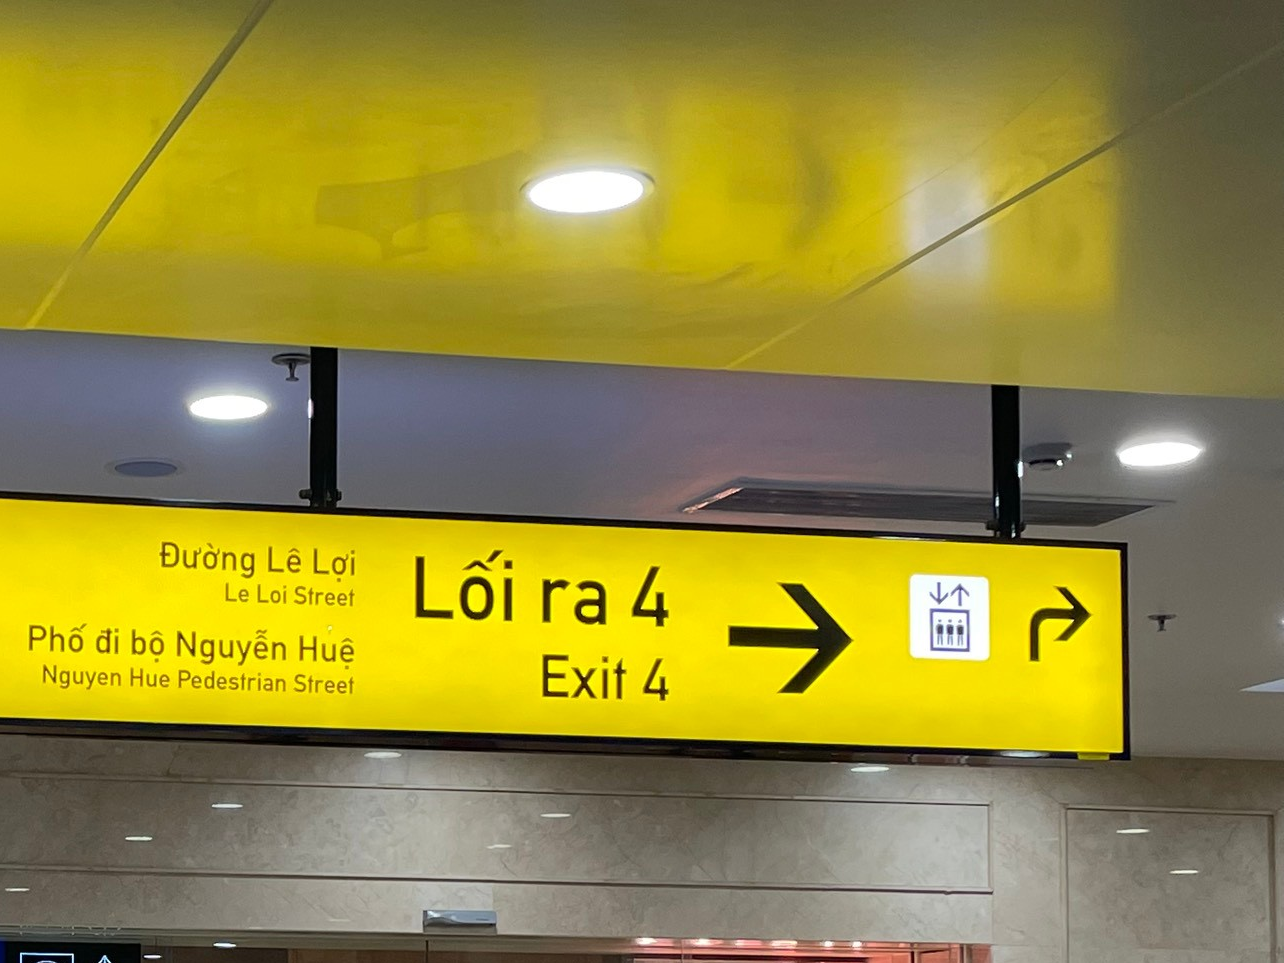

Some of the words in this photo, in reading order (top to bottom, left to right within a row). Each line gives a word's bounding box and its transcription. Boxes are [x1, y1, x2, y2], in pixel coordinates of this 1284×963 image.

[159, 541, 255, 579] Đường
[267, 546, 301, 574] Lê
[313, 548, 356, 583] Lợi
[225, 583, 250, 603] Le
[257, 584, 287, 605] Loi
[294, 586, 355, 607] Street
[415, 549, 514, 622] Lối
[542, 578, 607, 626] ra
[631, 566, 670, 627] 4
[28, 623, 87, 653] Phố
[95, 628, 119, 655] đi
[131, 629, 165, 663] bộ
[176, 629, 287, 666] Nguyễn
[298, 635, 355, 670] Huệ
[42, 664, 122, 690] Nguyen
[129, 667, 171, 688] Hue
[177, 669, 287, 692] Pedestrian
[293, 674, 355, 695] Street
[541, 654, 627, 700] Exit
[642, 658, 670, 701] 4
